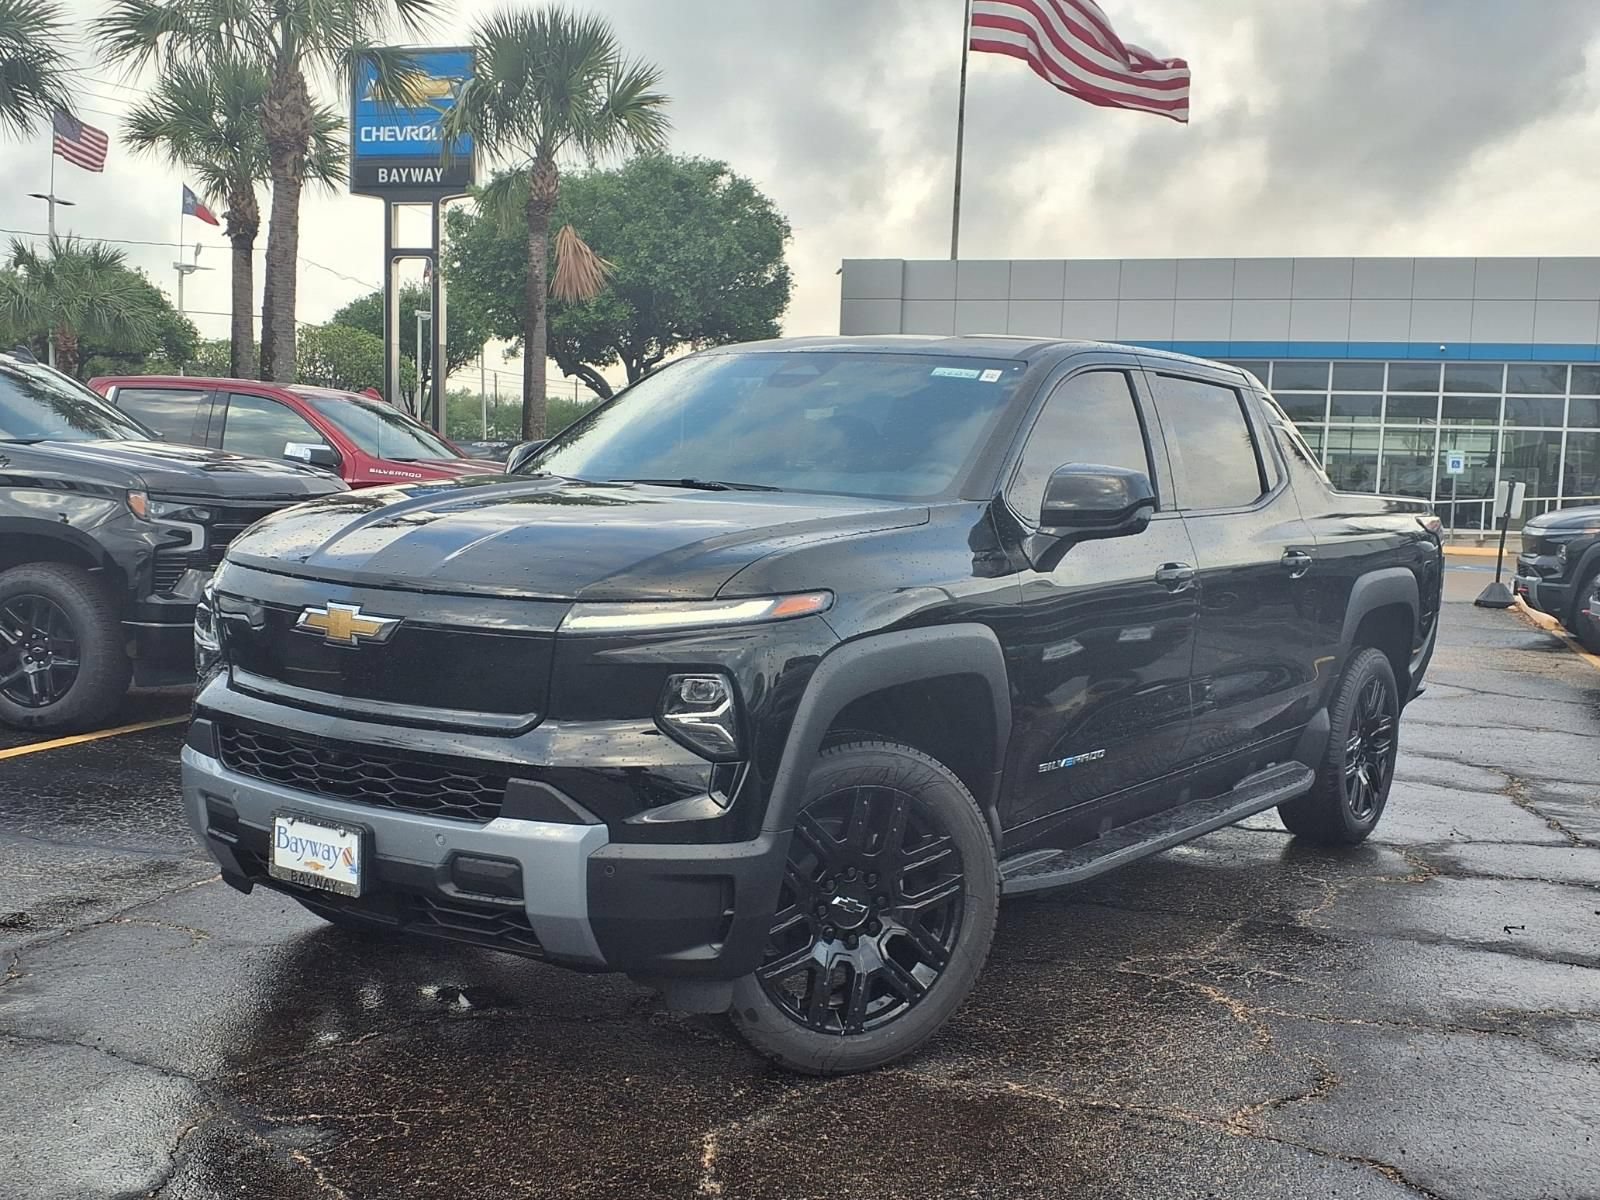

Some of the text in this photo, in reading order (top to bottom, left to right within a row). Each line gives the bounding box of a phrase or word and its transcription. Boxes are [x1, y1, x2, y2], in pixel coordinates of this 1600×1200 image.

[378, 167, 444, 183] BAYWAY
[369, 467, 422, 478] SILVERADO
[1038, 749, 1105, 773] SILVERADO
[275, 825, 343, 870] Bayway
